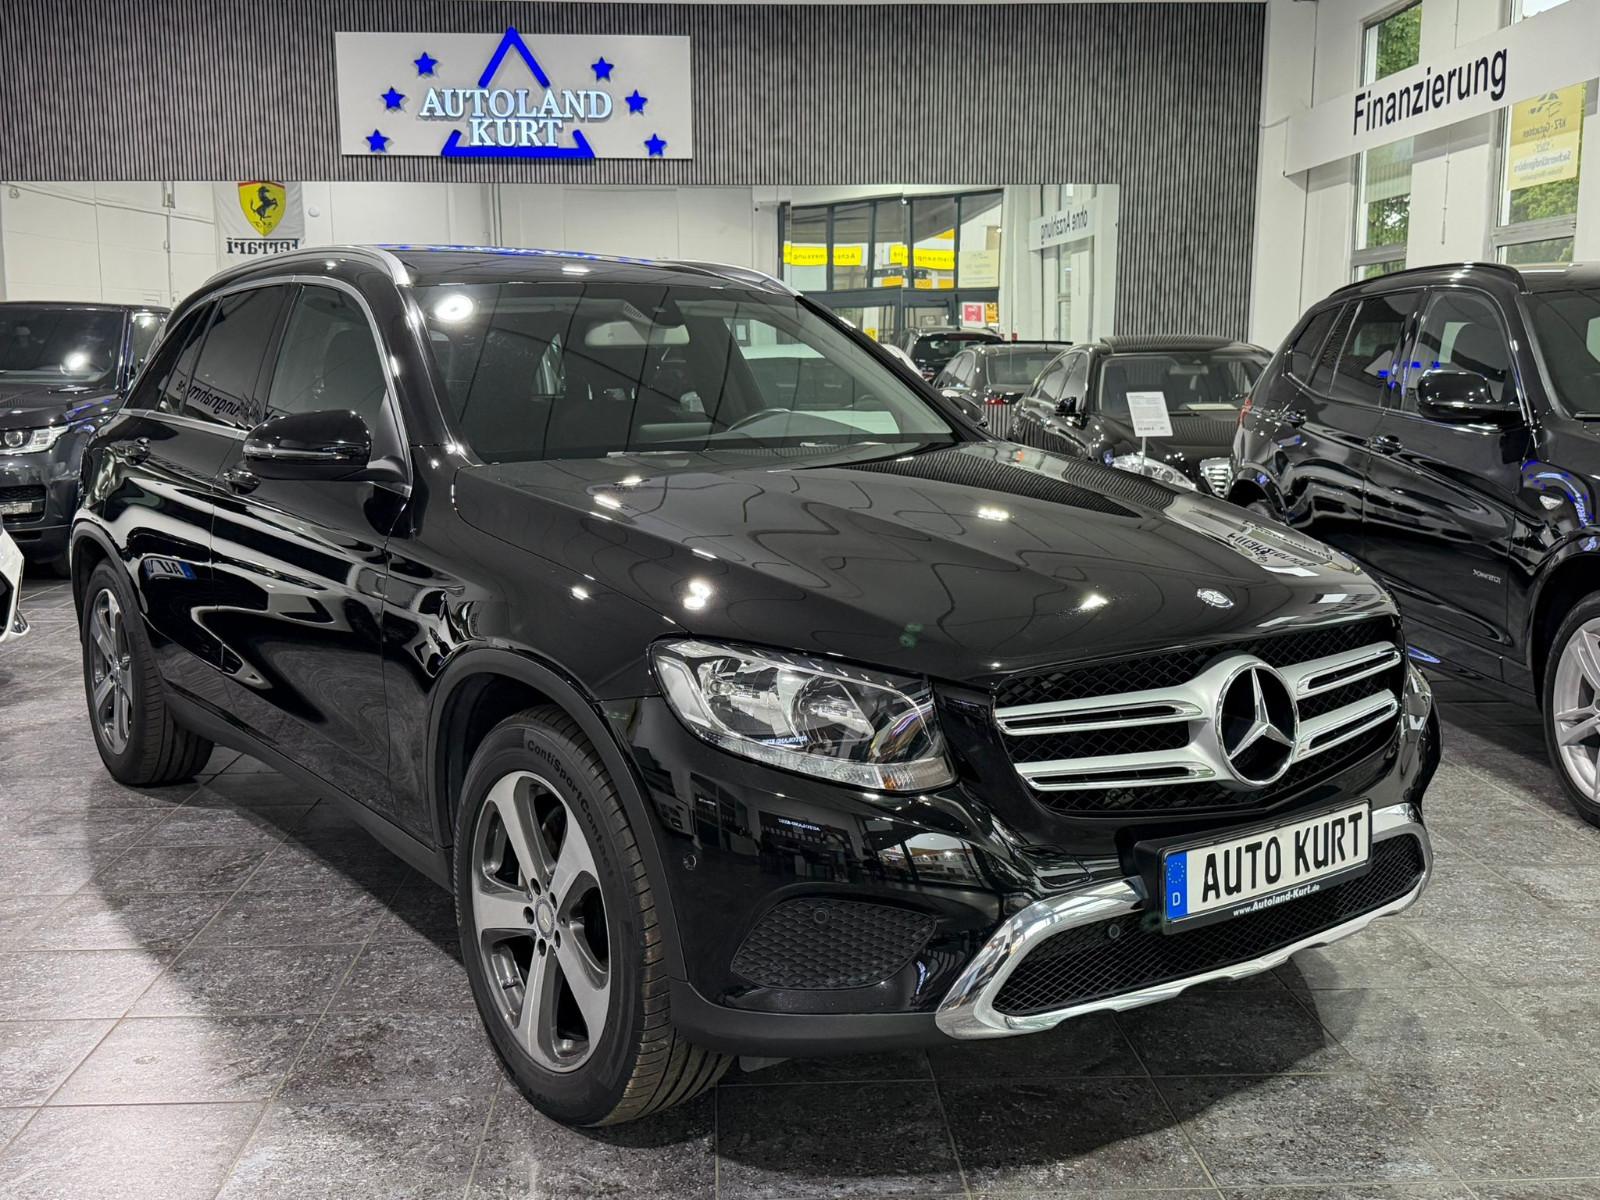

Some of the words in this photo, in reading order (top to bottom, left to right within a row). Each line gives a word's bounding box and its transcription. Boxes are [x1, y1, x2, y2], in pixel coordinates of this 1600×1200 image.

[419, 88, 612, 119] AUTOLAND
[1353, 48, 1508, 136] Finanzierung
[469, 118, 562, 147] KURT
[1202, 836, 1282, 902] AUTO
[1295, 811, 1362, 876] KURT
[1172, 891, 1181, 906] D
[1233, 883, 1320, 917] www.Autoland-Kurt.de
